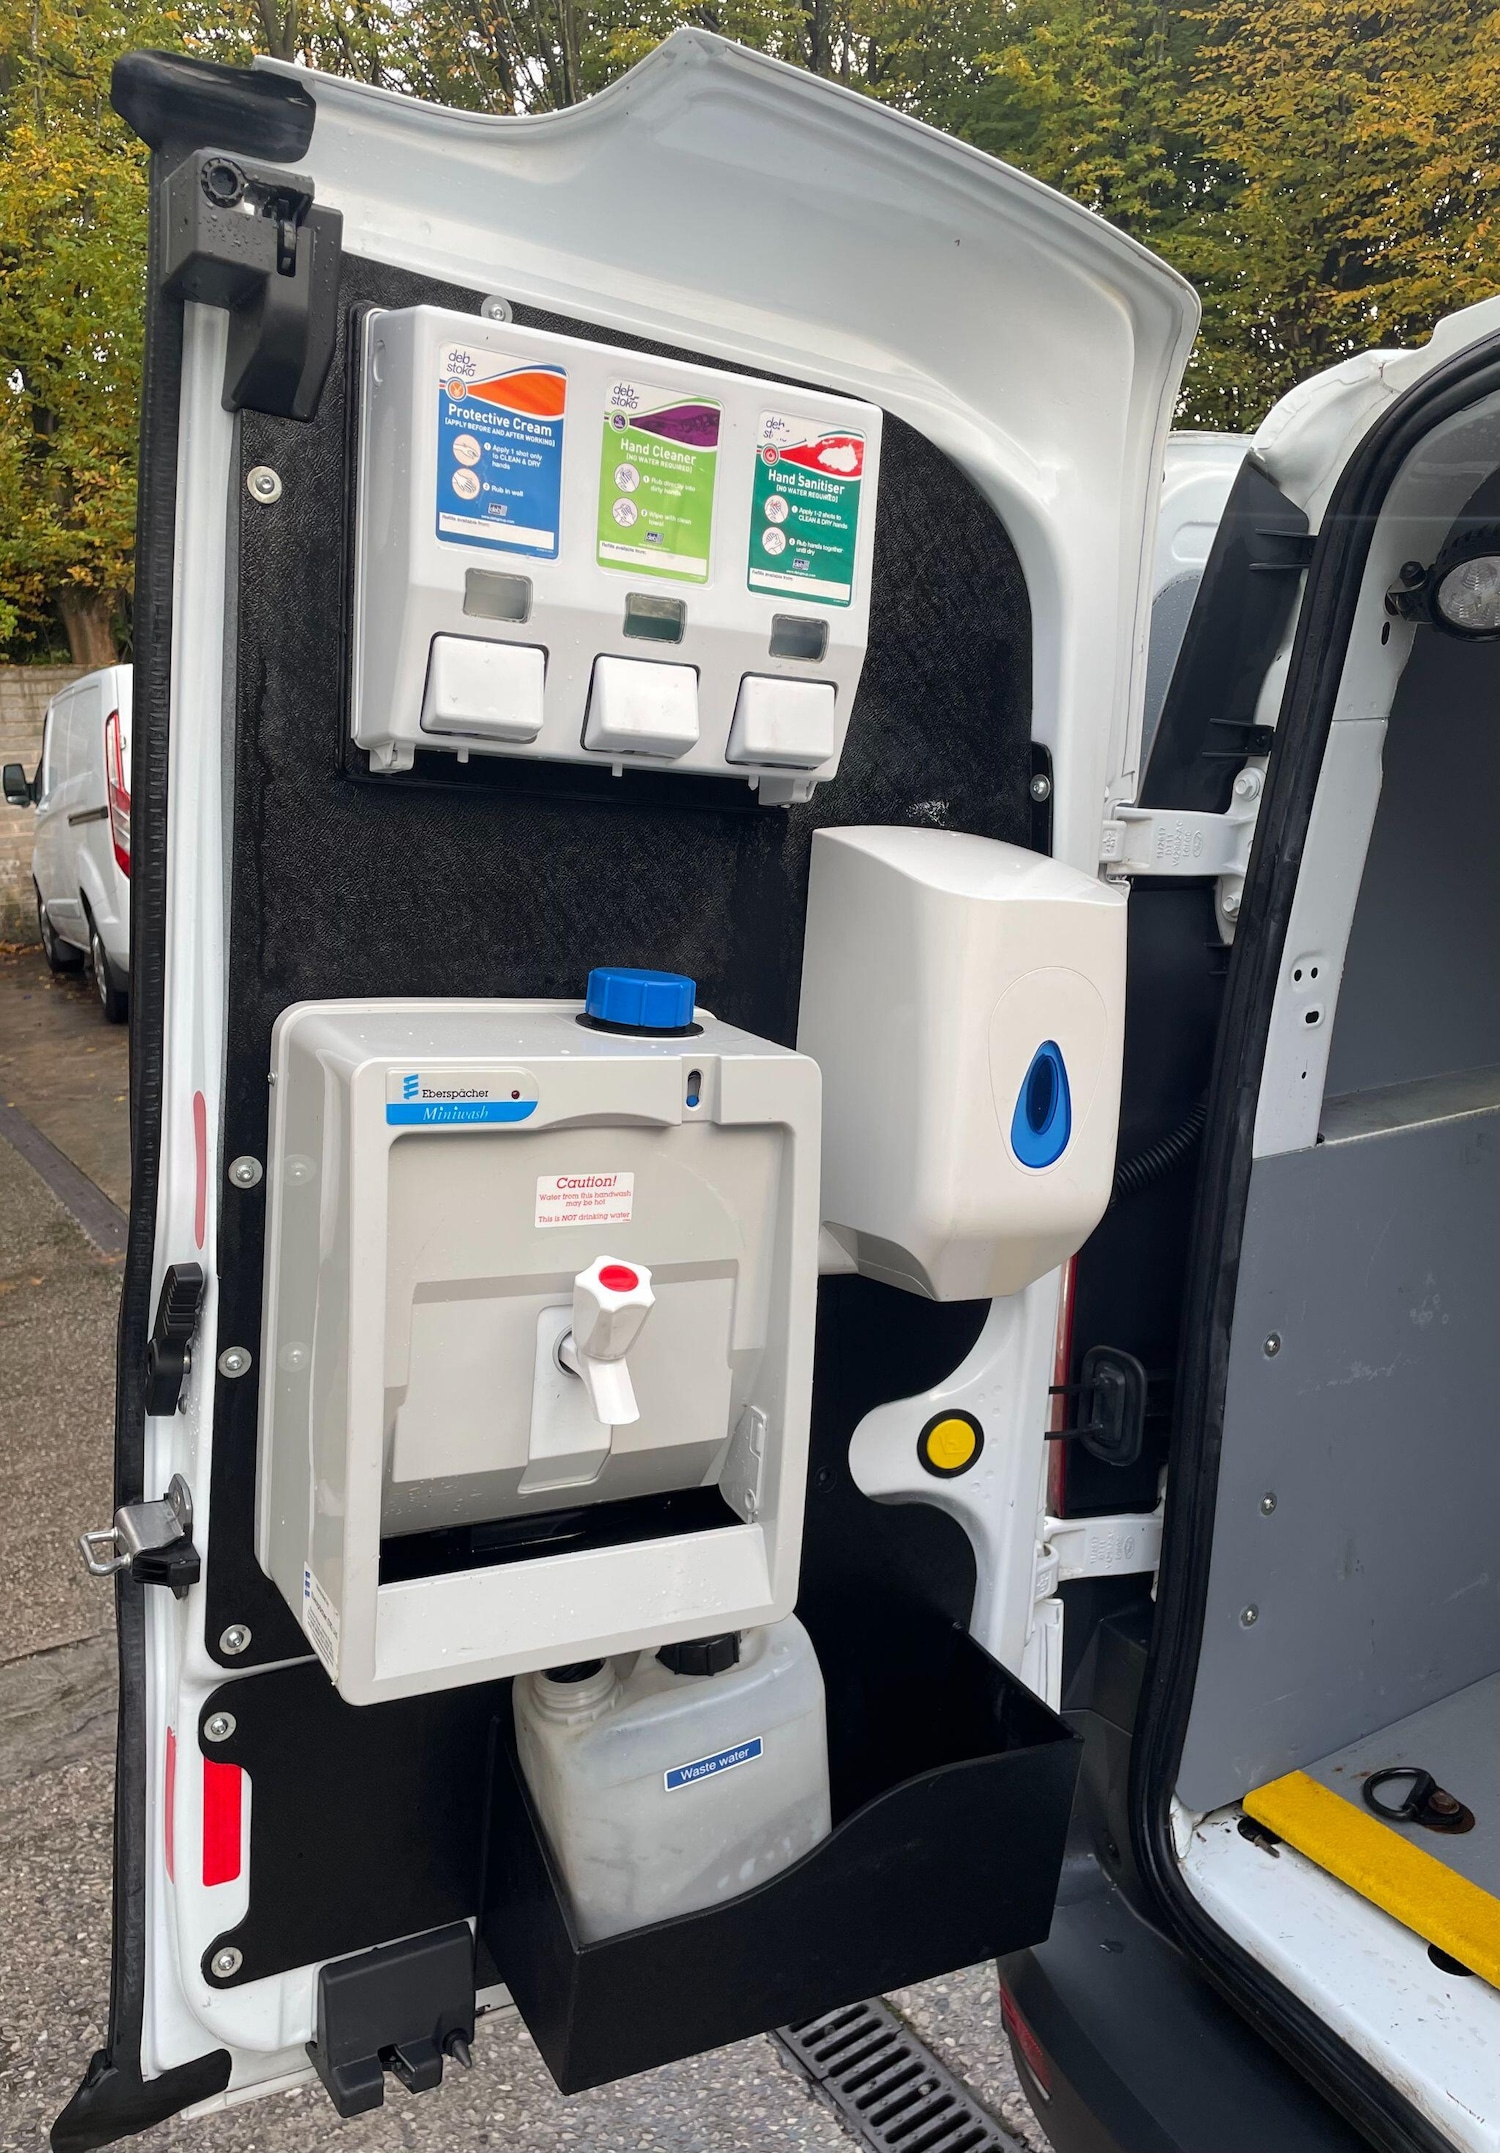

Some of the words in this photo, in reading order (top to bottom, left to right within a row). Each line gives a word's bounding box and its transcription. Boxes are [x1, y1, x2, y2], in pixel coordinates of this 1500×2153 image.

[449, 350, 470, 364] deb
[614, 383, 634, 398] deb
[449, 404, 510, 427] Protective
[513, 418, 551, 436] Cream
[468, 423, 491, 433] BEFORE
[492, 427, 505, 436] AND
[506, 429, 524, 440] AFTER
[492, 445, 509, 455] Apply
[516, 450, 528, 458] shot
[530, 453, 542, 461] only
[621, 438, 649, 455] Hand
[653, 445, 696, 465] Cleaner
[492, 461, 510, 470] hands
[500, 454, 520, 464] CLEAN
[528, 459, 541, 467] DRY
[638, 455, 660, 465] WATER
[651, 478, 662, 486] Rub
[664, 480, 684, 490] directly
[768, 469, 796, 485] Hand
[798, 475, 845, 494] Sanitiser
[491, 485, 504, 494] Rub
[512, 489, 523, 497] well
[650, 486, 663, 494] dirty
[664, 488, 681, 496] hands
[788, 487, 807, 496] WATER
[649, 511, 663, 521] Wipe
[677, 517, 692, 525] clean
[798, 515, 816, 524] CLEAN
[799, 508, 814, 516] Apply
[822, 512, 836, 520] shots
[457, 517, 477, 525] available
[649, 519, 664, 527] towel
[807, 541, 822, 550] hands
[823, 545, 843, 554] together
[422, 1089, 488, 1099] Eberspächer
[422, 1105, 488, 1120] Miniwash
[556, 1176, 617, 1189] Caution!
[594, 1190, 631, 1198] handwash
[578, 1213, 608, 1221] drinking
[680, 1762, 716, 1780] Waste
[719, 1748, 749, 1767] water
